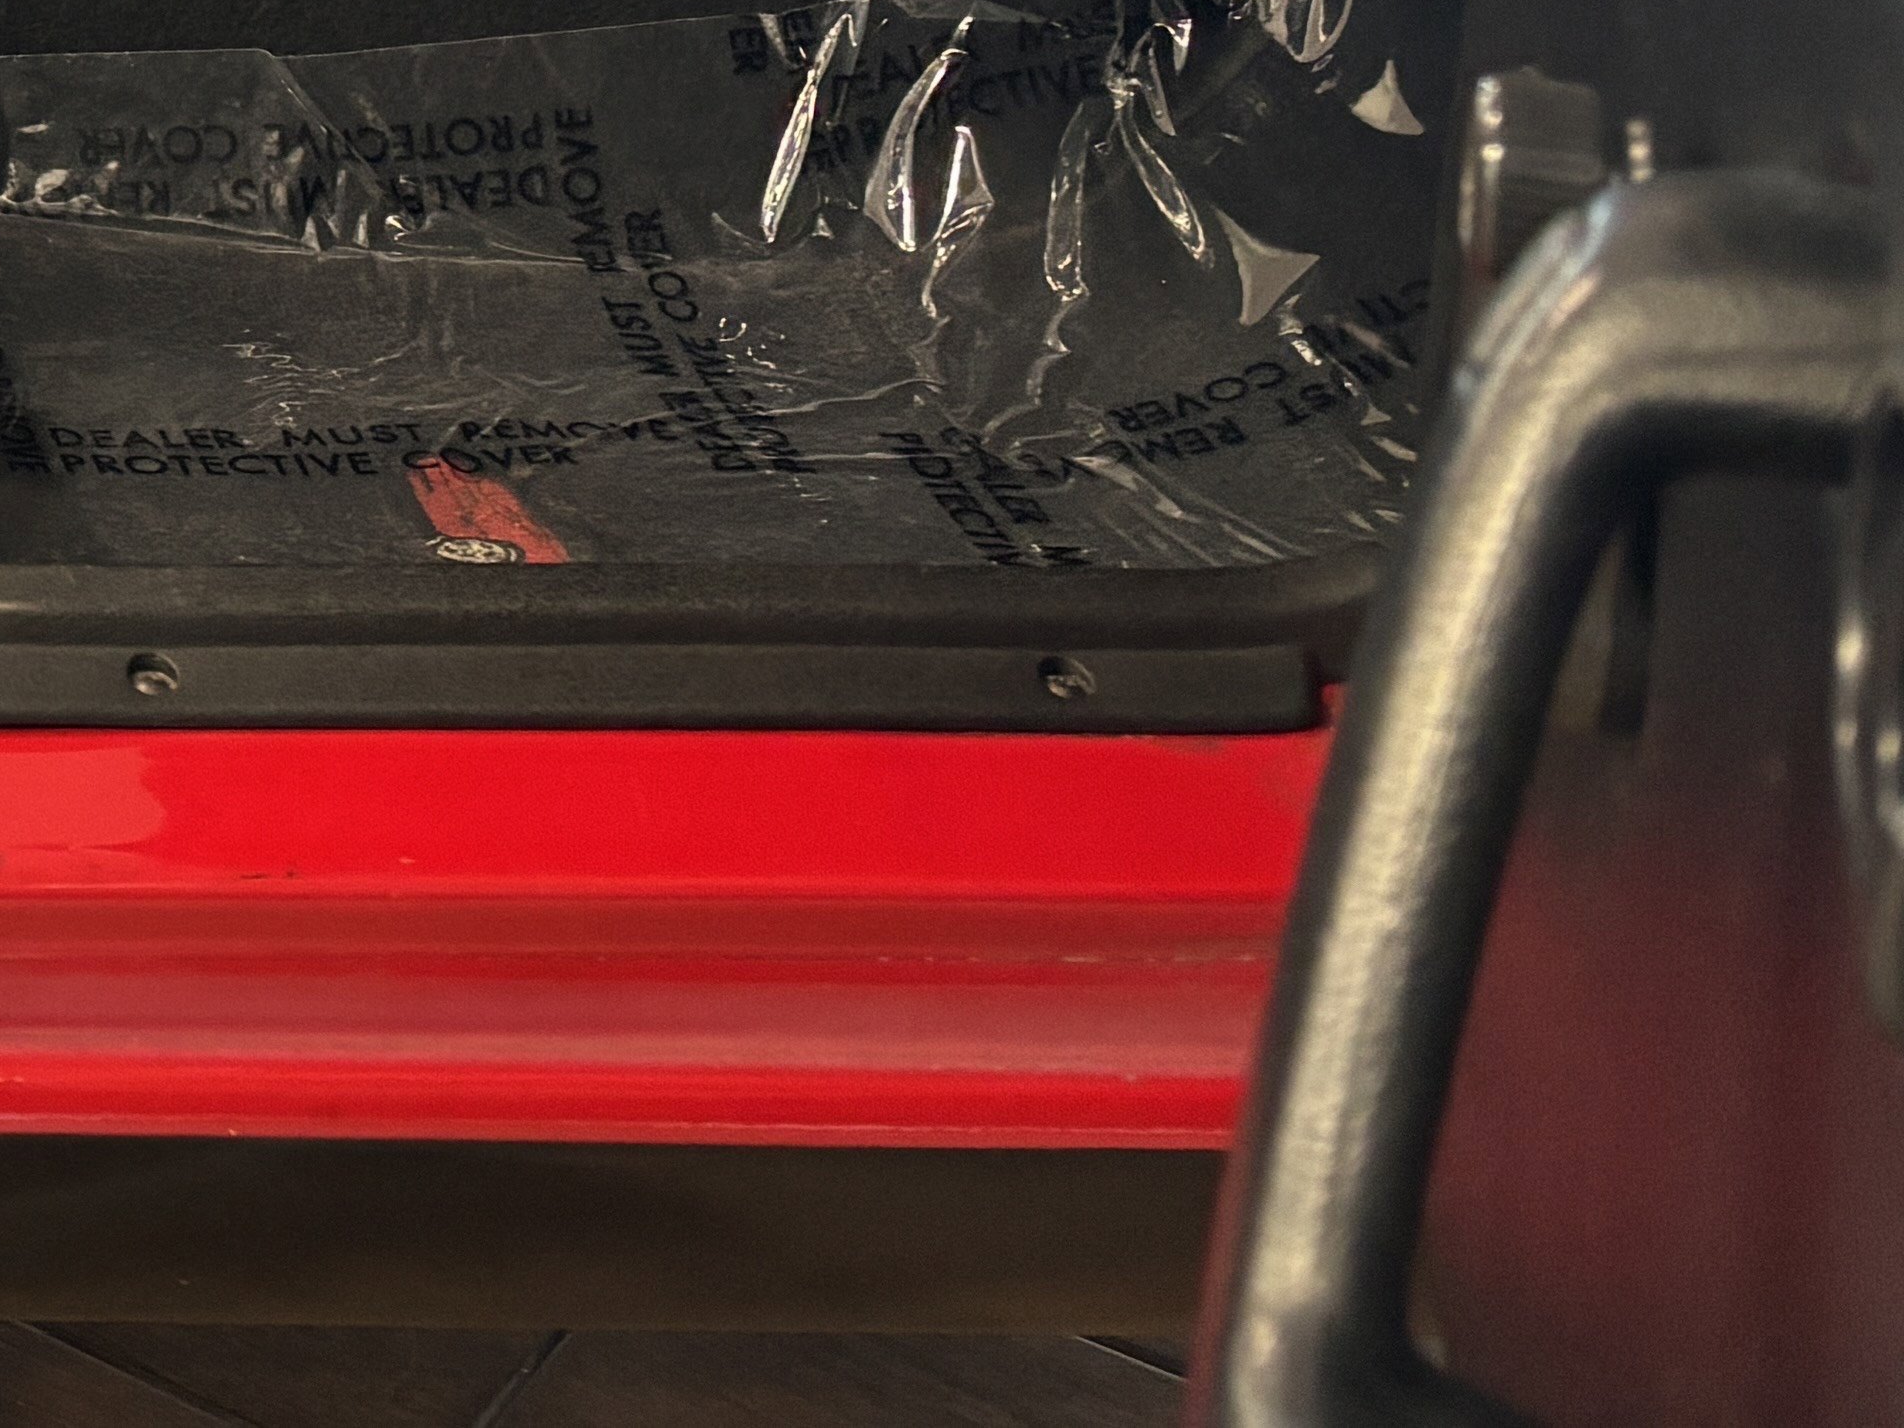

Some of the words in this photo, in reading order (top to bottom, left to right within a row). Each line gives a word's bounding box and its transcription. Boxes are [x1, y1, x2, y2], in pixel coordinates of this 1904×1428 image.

[555, 107, 620, 274] EMOVE
[1108, 361, 1287, 432] COVER
[49, 427, 242, 449] DEALER
[282, 422, 420, 448] MUST
[61, 450, 380, 478] PROTECTIVE
[401, 446, 579, 475] COVER
